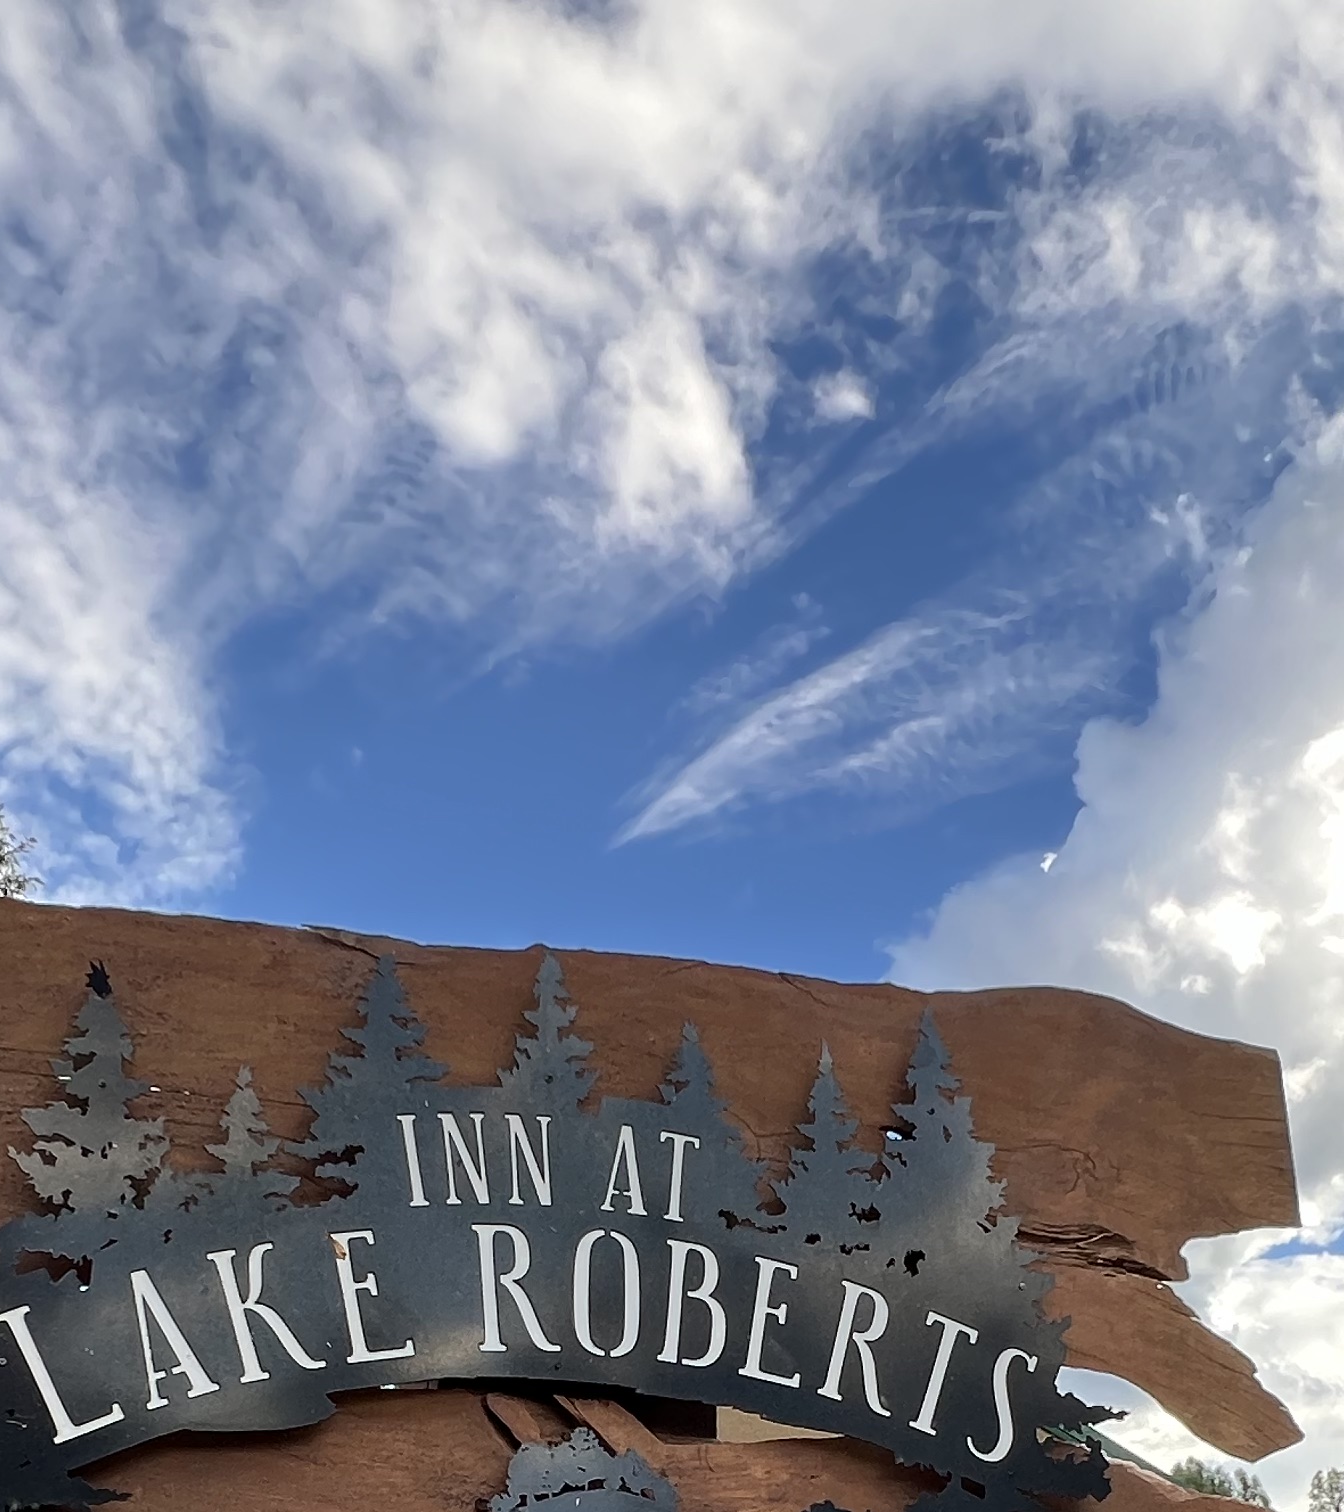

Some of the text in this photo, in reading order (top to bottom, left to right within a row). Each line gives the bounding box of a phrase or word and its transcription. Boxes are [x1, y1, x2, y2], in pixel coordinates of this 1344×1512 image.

[396, 1113, 701, 1222] INN AT
[471, 1224, 1039, 1464] ROBERTS
